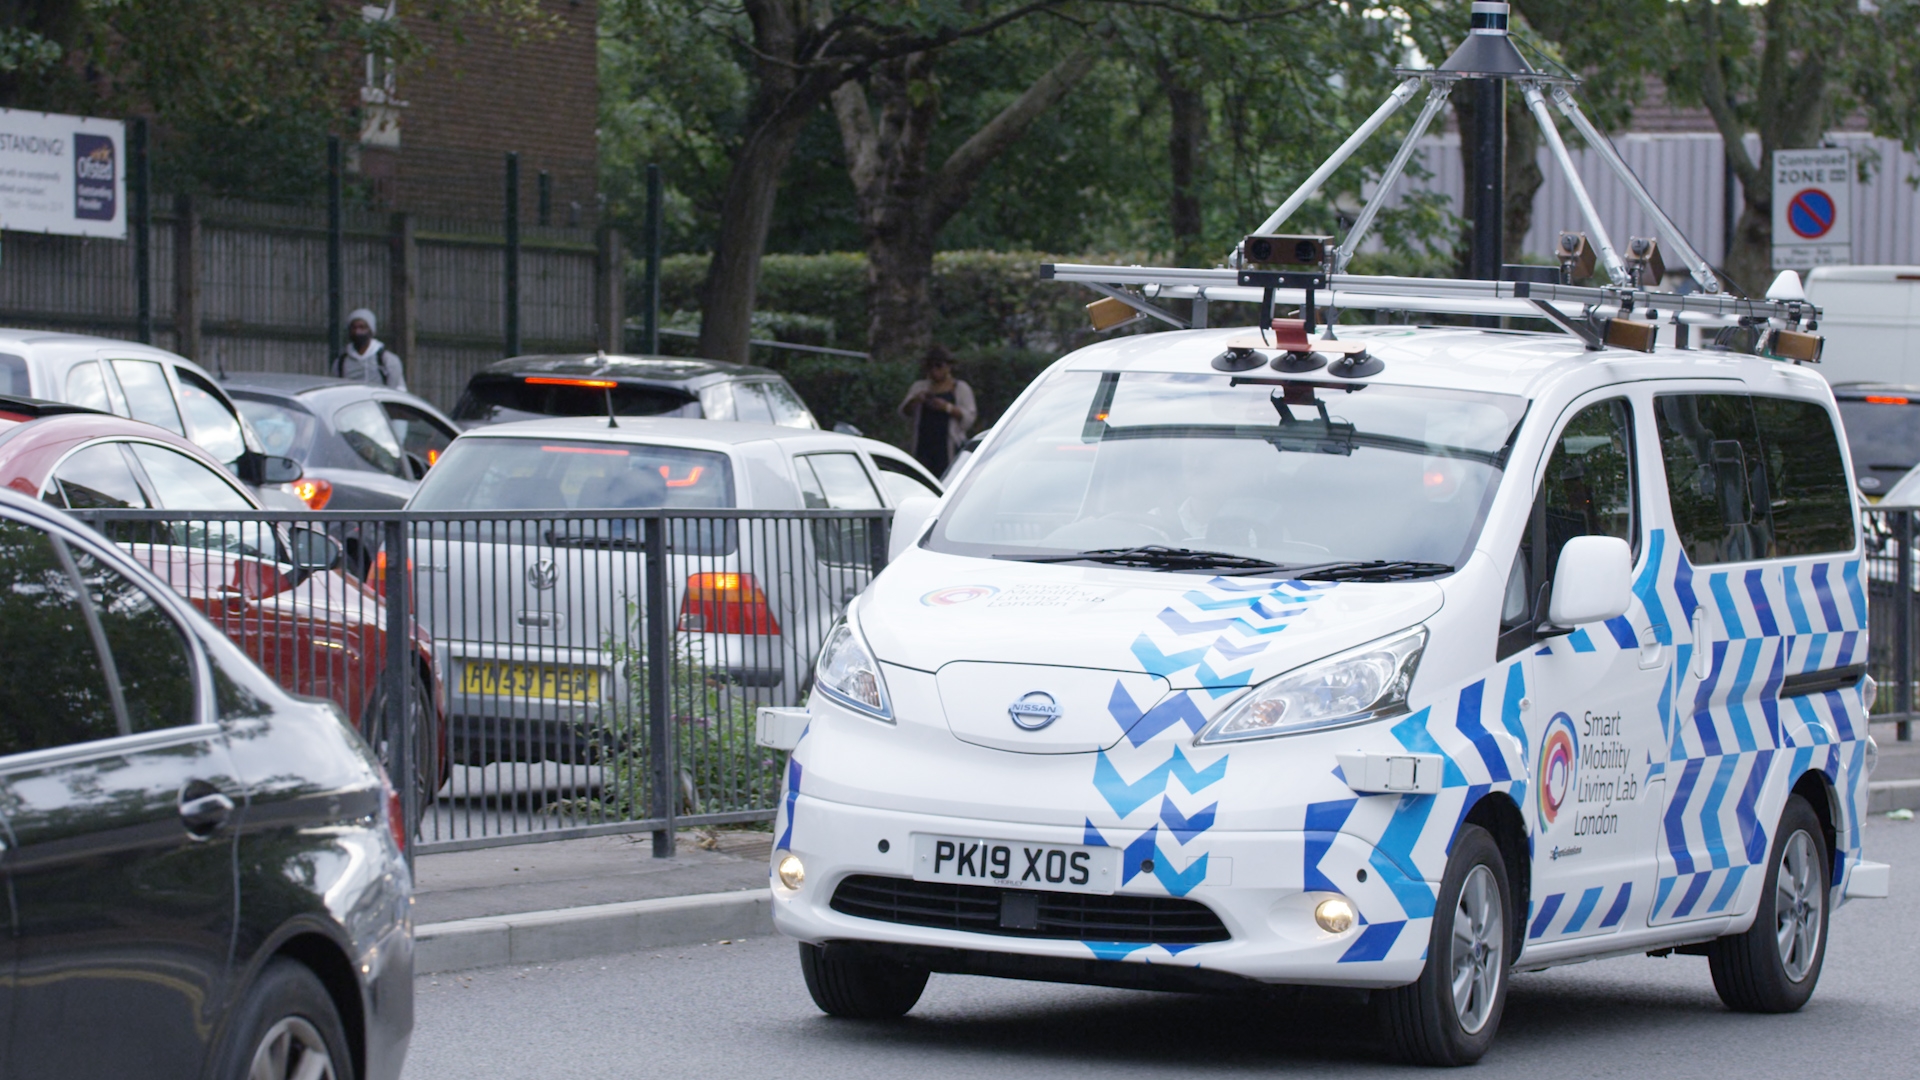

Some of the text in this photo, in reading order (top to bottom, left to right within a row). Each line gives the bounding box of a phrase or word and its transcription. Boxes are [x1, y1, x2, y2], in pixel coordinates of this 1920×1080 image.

[77, 156, 113, 180] Ofsted
[1778, 154, 1845, 166] Controlled
[1778, 169, 1825, 184] ZONE
[1003, 588, 1095, 597] Mobility
[986, 600, 1068, 608] London
[1012, 703, 1057, 713] NISSAN
[1583, 710, 1622, 737] Smart
[1580, 741, 1631, 774] Mobility
[1578, 774, 1638, 807] Living Lab
[1574, 807, 1618, 836] London
[934, 840, 1091, 885] PK19 XOS
[993, 878, 1024, 887] CHORLEY
